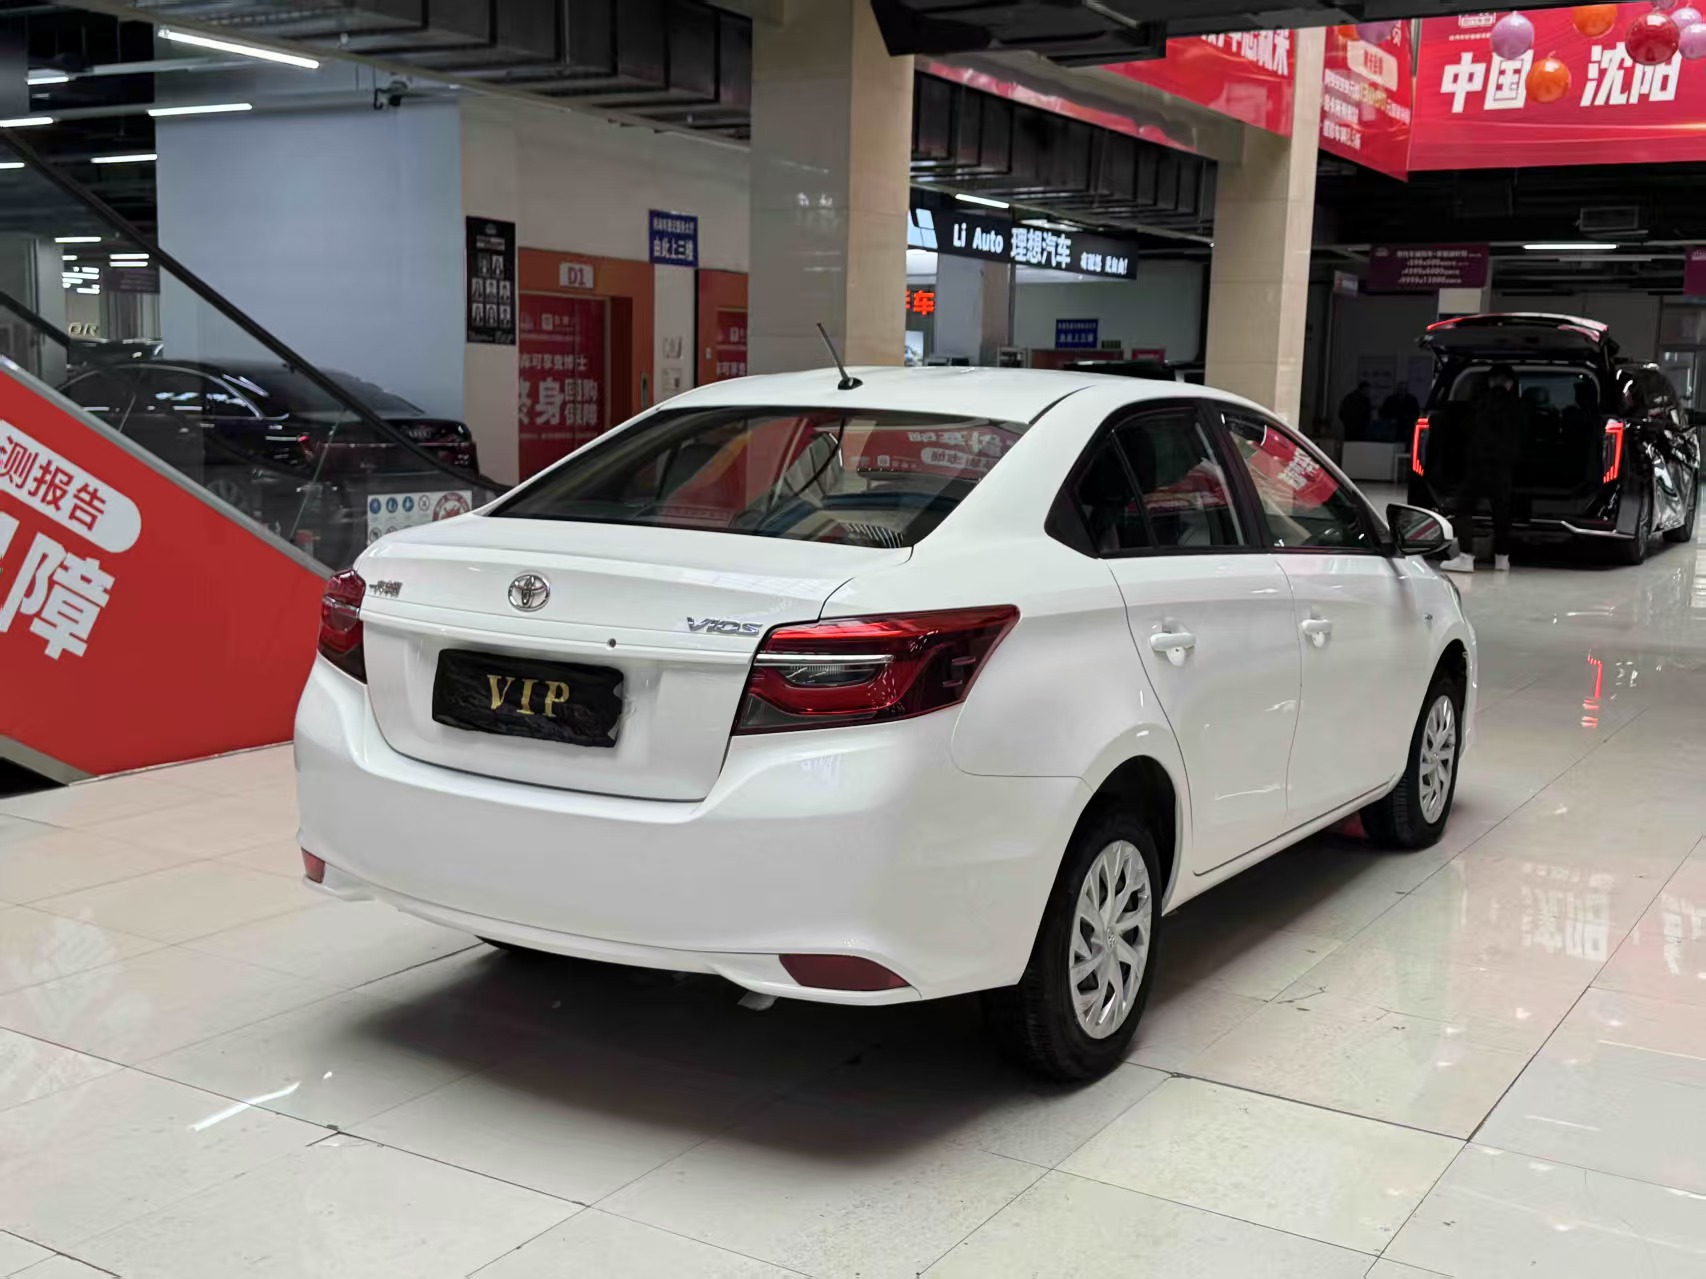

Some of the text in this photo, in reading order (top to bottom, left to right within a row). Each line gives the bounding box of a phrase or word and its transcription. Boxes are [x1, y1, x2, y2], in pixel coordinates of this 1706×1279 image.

[1440, 49, 1534, 113] 中国
[1579, 41, 1682, 107] 沈阳
[953, 222, 967, 248] Li
[972, 227, 1004, 253] Auto
[1010, 228, 1072, 269] 理想汽车
[568, 266, 586, 286] D1
[905, 289, 935, 316] 车
[518, 353, 588, 371] 车可享查博士
[0, 435, 107, 532] 测报告
[0, 511, 116, 660] 障
[687, 616, 763, 636] VIOS
[486, 673, 570, 718] VIP
